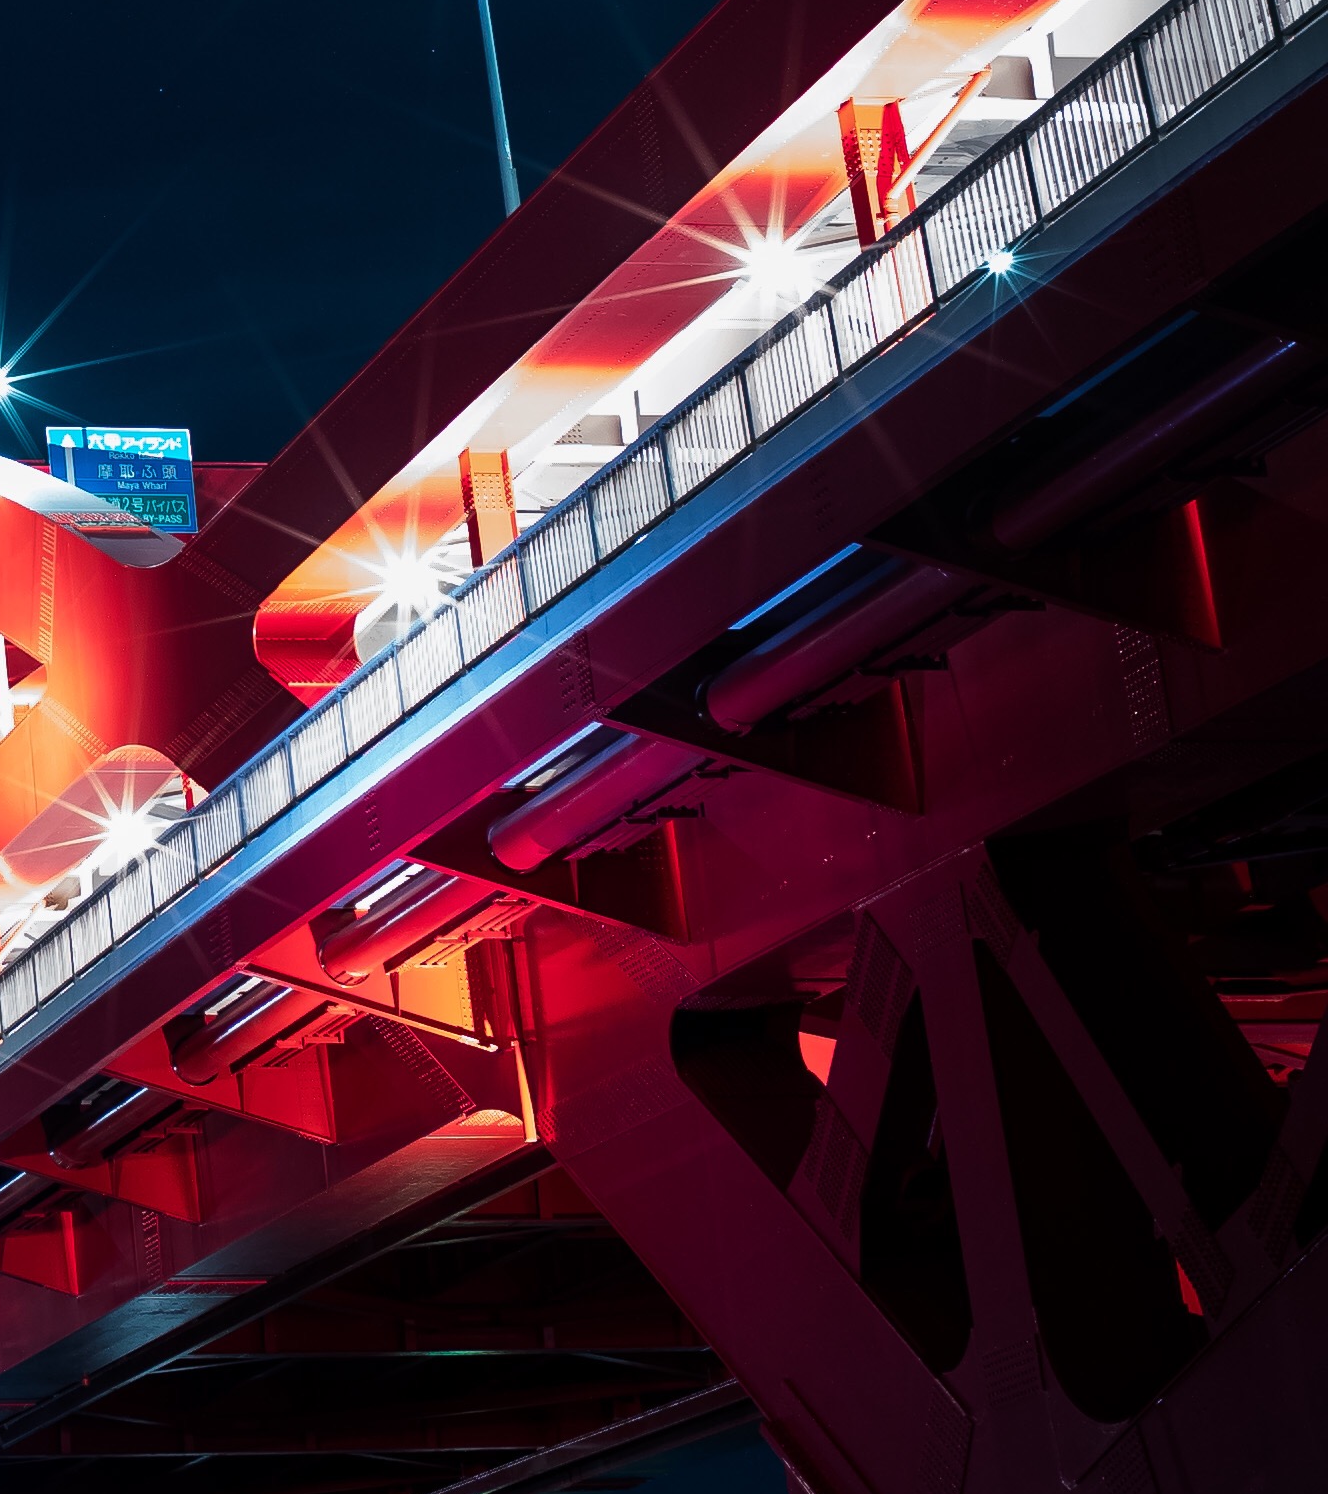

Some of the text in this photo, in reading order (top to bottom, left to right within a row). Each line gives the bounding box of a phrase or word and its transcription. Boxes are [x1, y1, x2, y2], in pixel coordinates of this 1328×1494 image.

[97, 463, 178, 480] 摩耶ふ頭
[117, 481, 167, 491] Maya Wharf
[142, 514, 183, 524] BY-PASS
